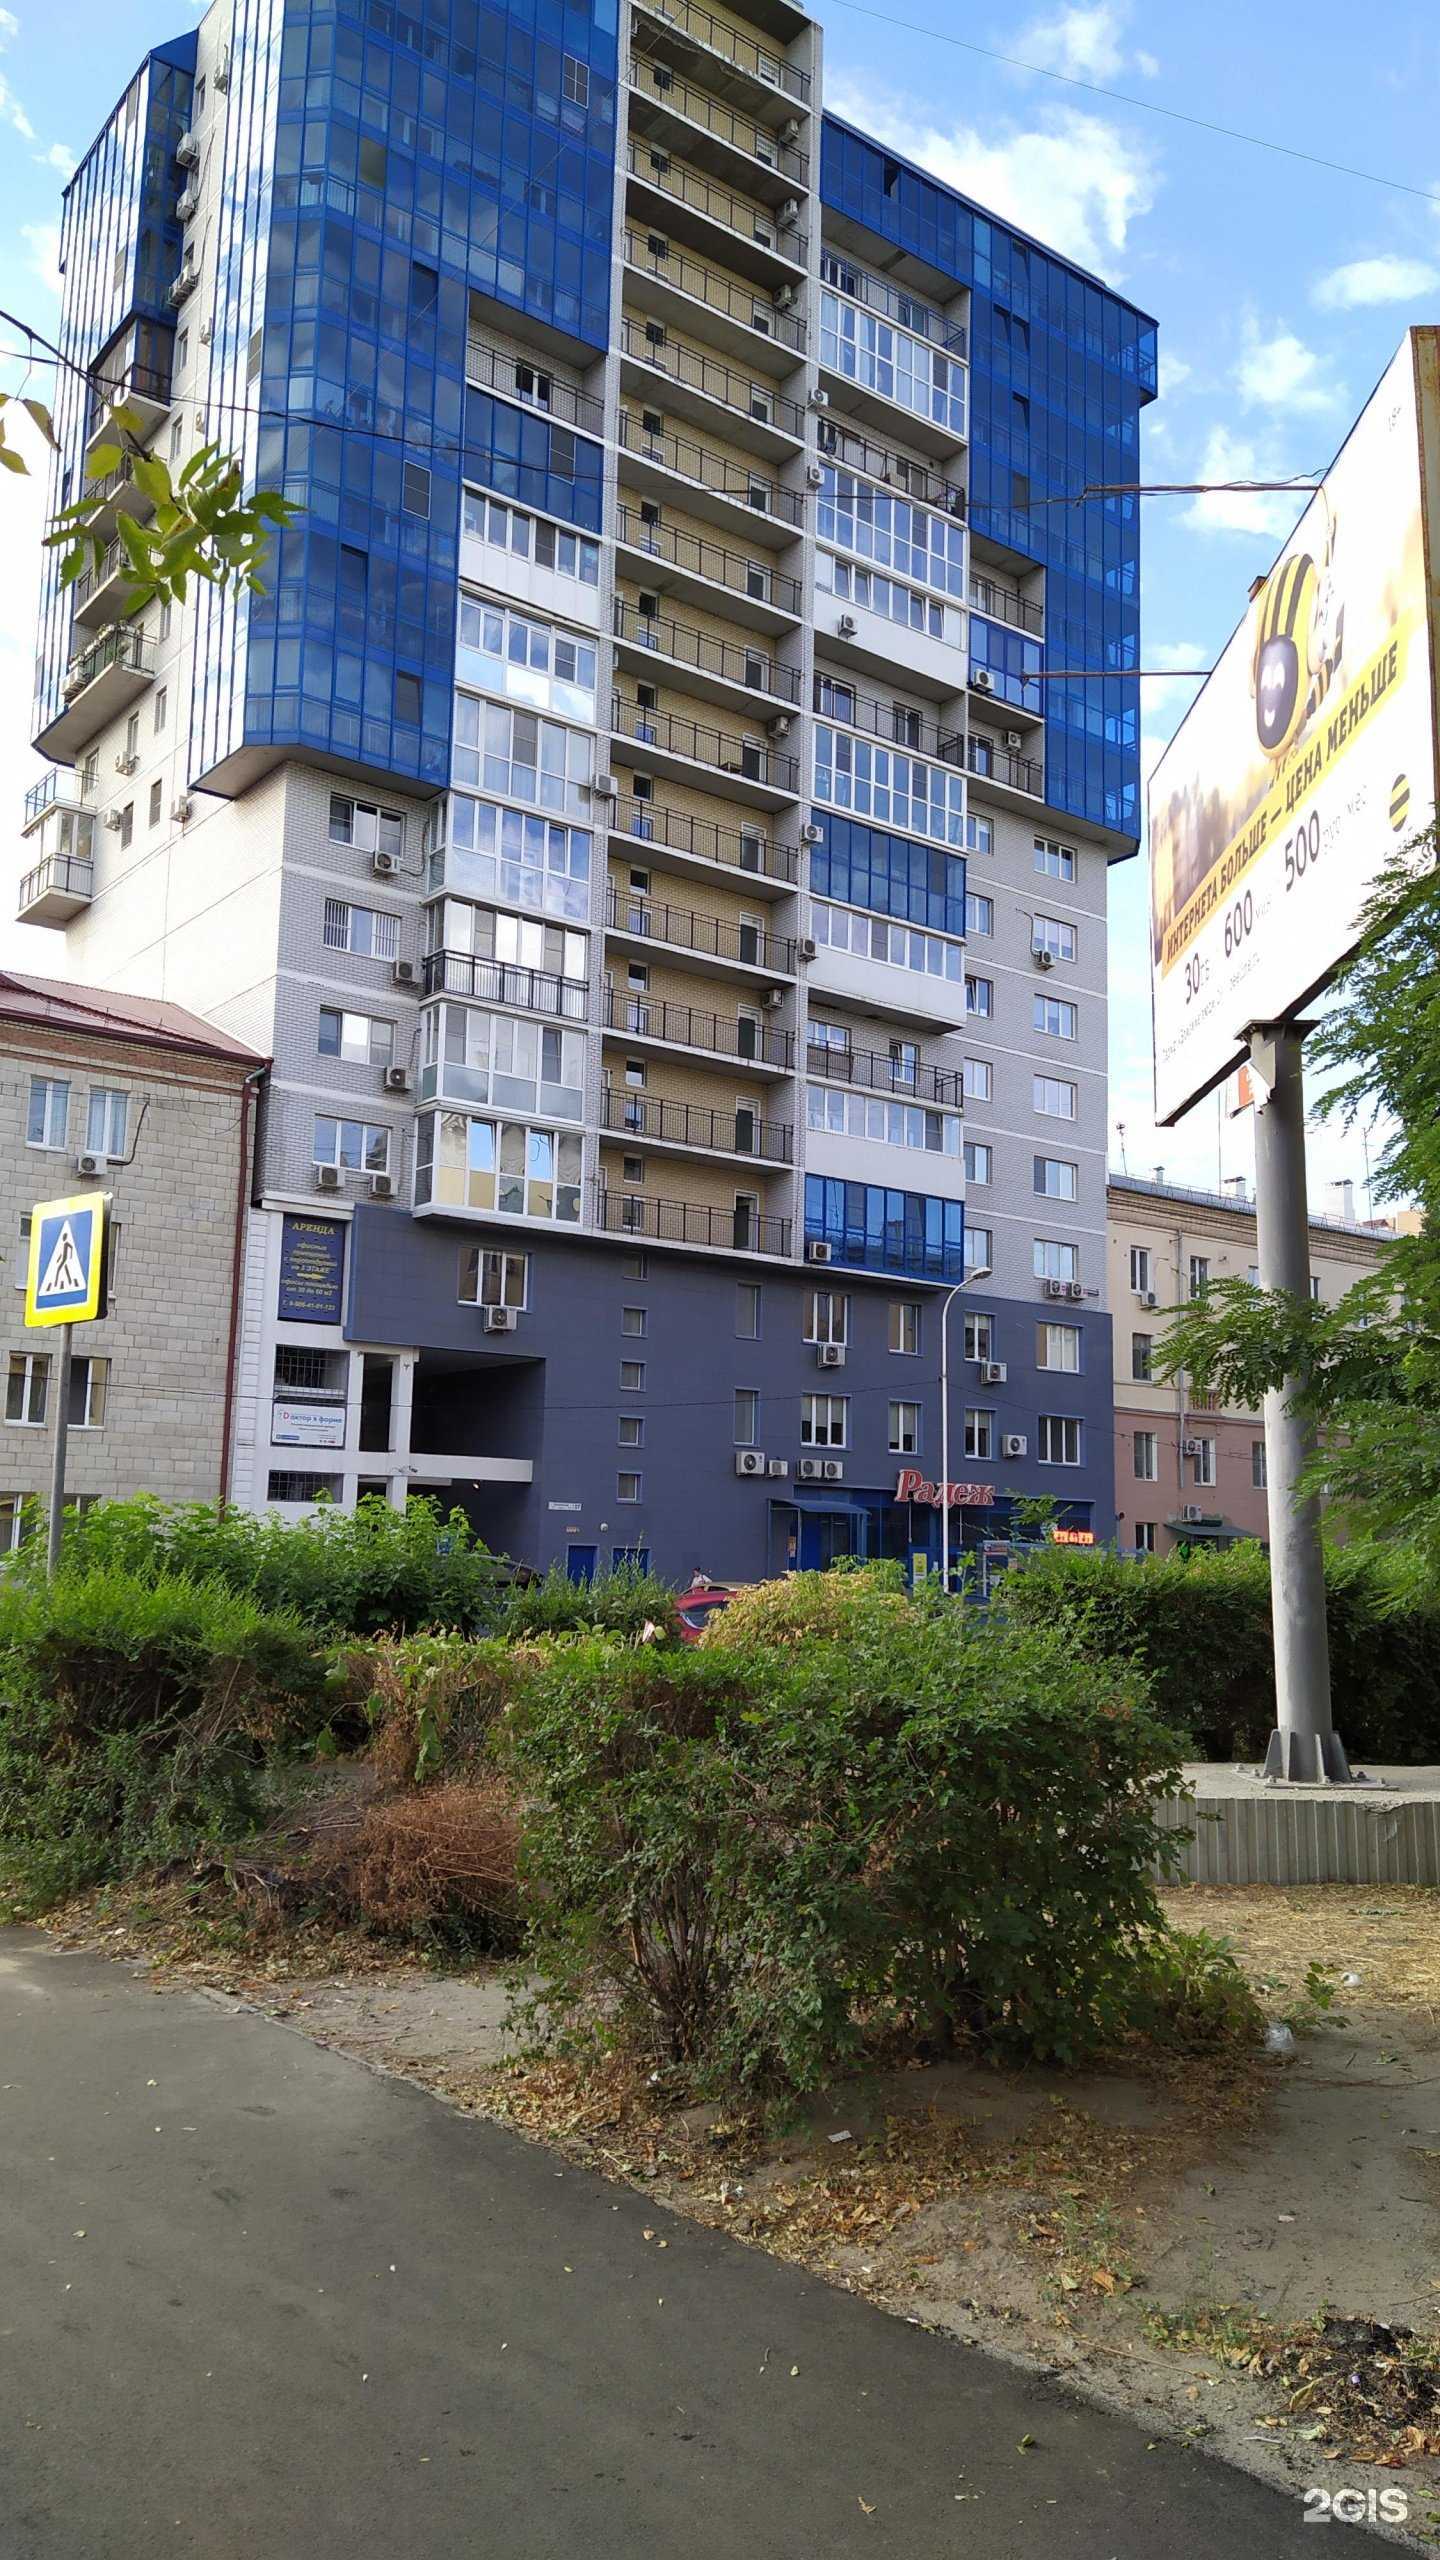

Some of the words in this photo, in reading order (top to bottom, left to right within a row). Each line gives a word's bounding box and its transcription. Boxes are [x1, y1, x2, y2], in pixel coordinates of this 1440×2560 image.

[1167, 877, 1217, 964] ИНТЕРНЕТА
[1220, 811, 1267, 894] БОЛЬШЕ
[1286, 741, 1322, 813] ЦЕНА
[1326, 640, 1398, 761] МЕНЬШЕ
[1185, 953, 1200, 1005] 30
[1225, 889, 1253, 958] 600
[1285, 810, 1320, 892] 500
[292, 1222, 335, 1235] АРЕНДА
[894, 1468, 996, 1509] Радеж
